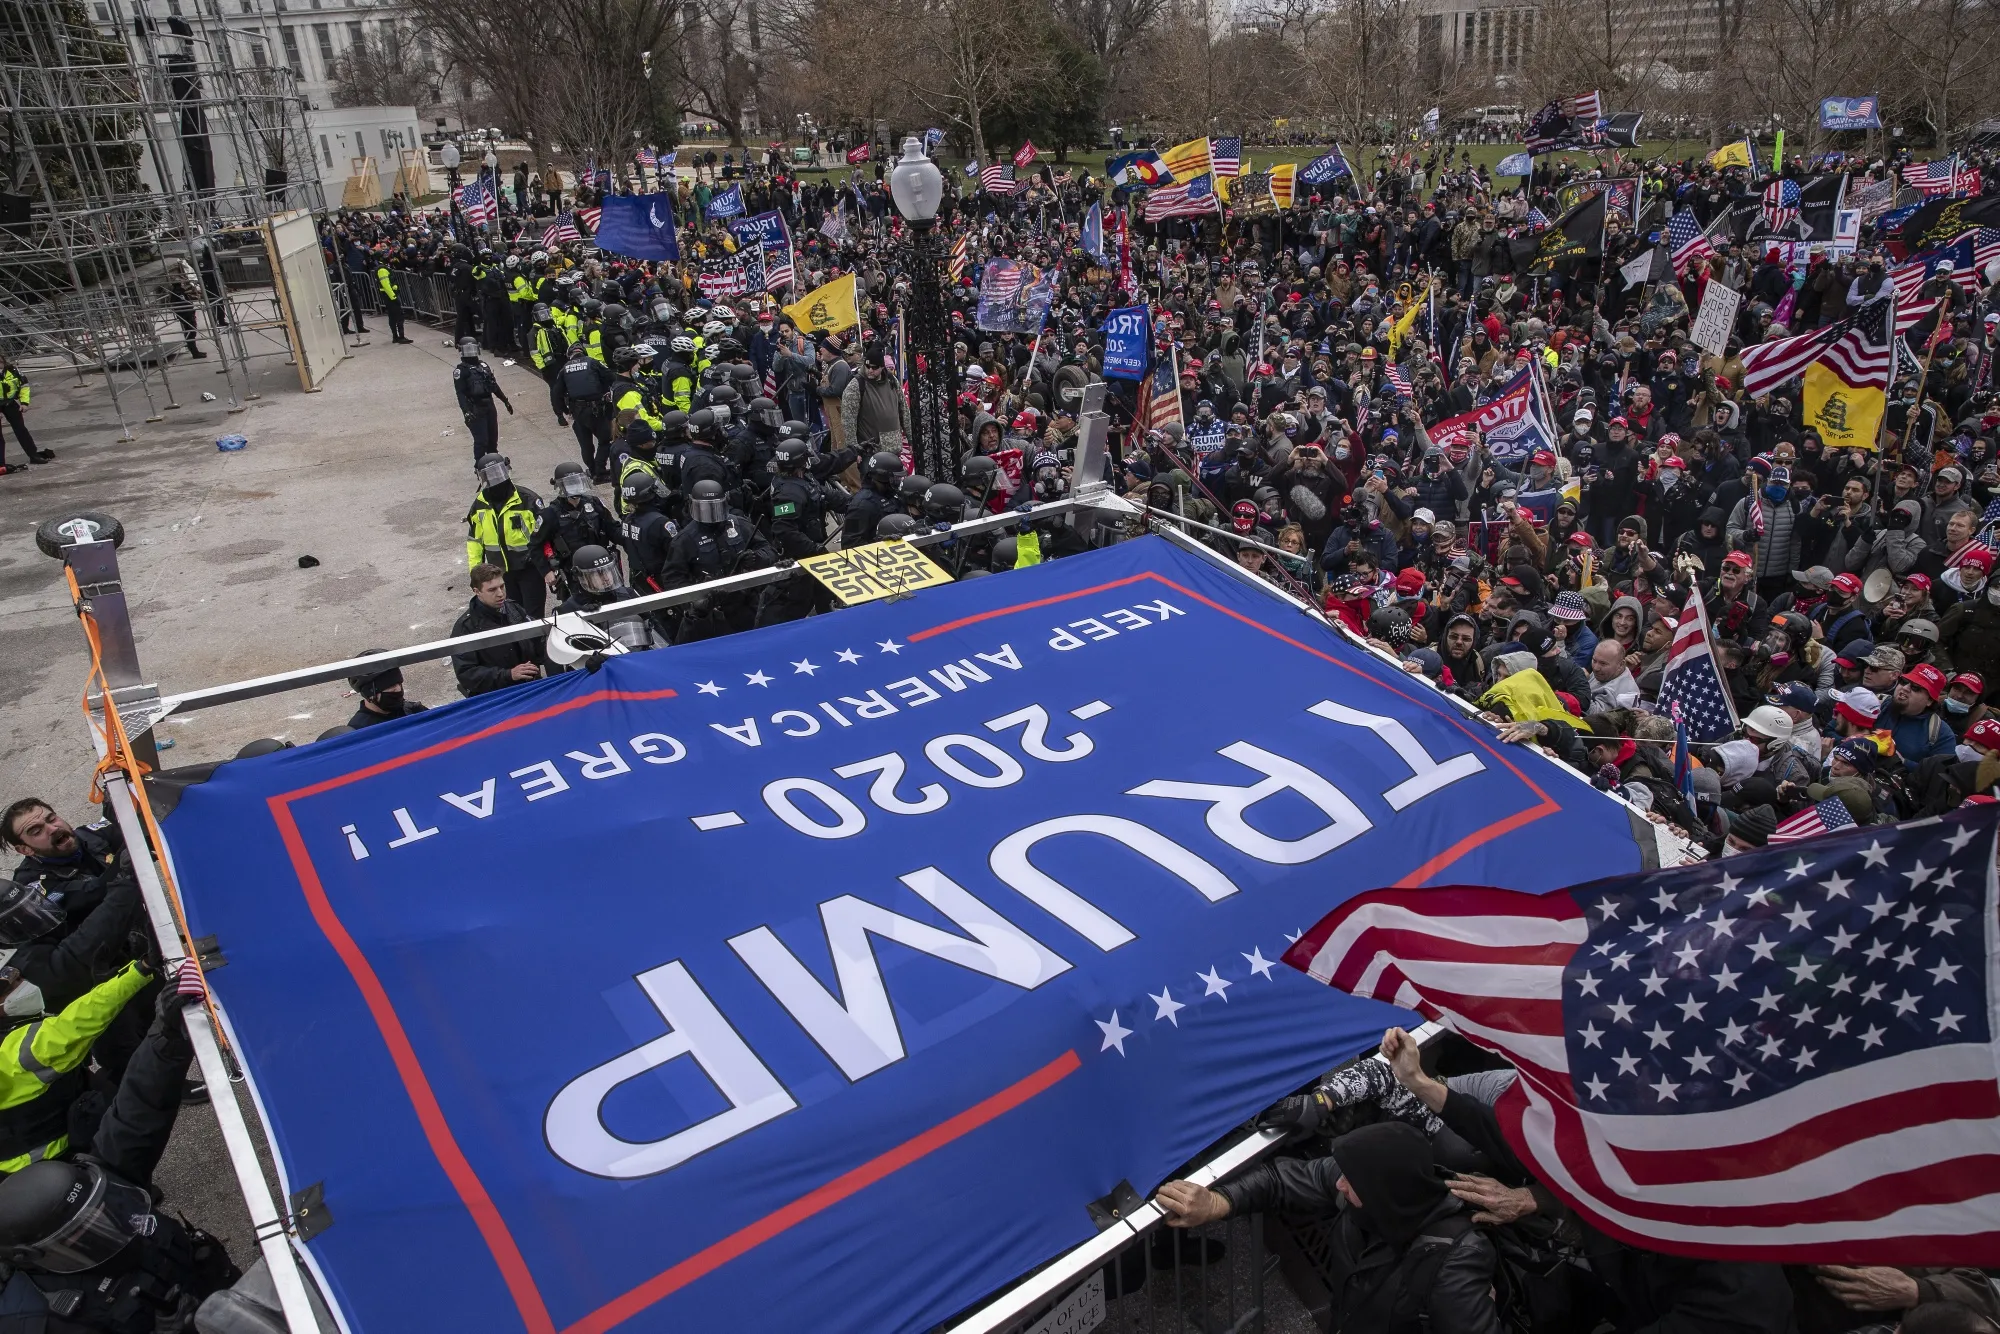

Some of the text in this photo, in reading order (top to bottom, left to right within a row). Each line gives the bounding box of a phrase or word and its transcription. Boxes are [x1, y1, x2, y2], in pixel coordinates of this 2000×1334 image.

[1703, 294, 1731, 317] WORD
[1708, 281, 1738, 307] GOD'S
[1699, 321, 1721, 342] DEM
[1700, 307, 1729, 331] CALLS
[565, 364, 588, 374] POLICE
[1249, 474, 1263, 487] W
[780, 505, 789, 513] 12
[809, 543, 920, 580] SAVES
[831, 561, 934, 598] JESUS
[338, 599, 1187, 862] KEEP AMERICA GREAT!
[689, 699, 1114, 841] -2020-
[541, 698, 1488, 1181] TRUMP
[66, 1182, 84, 1204] 5018
[1057, 1283, 1103, 1326] OF U.S.
[1063, 1303, 1100, 1334] LICE
